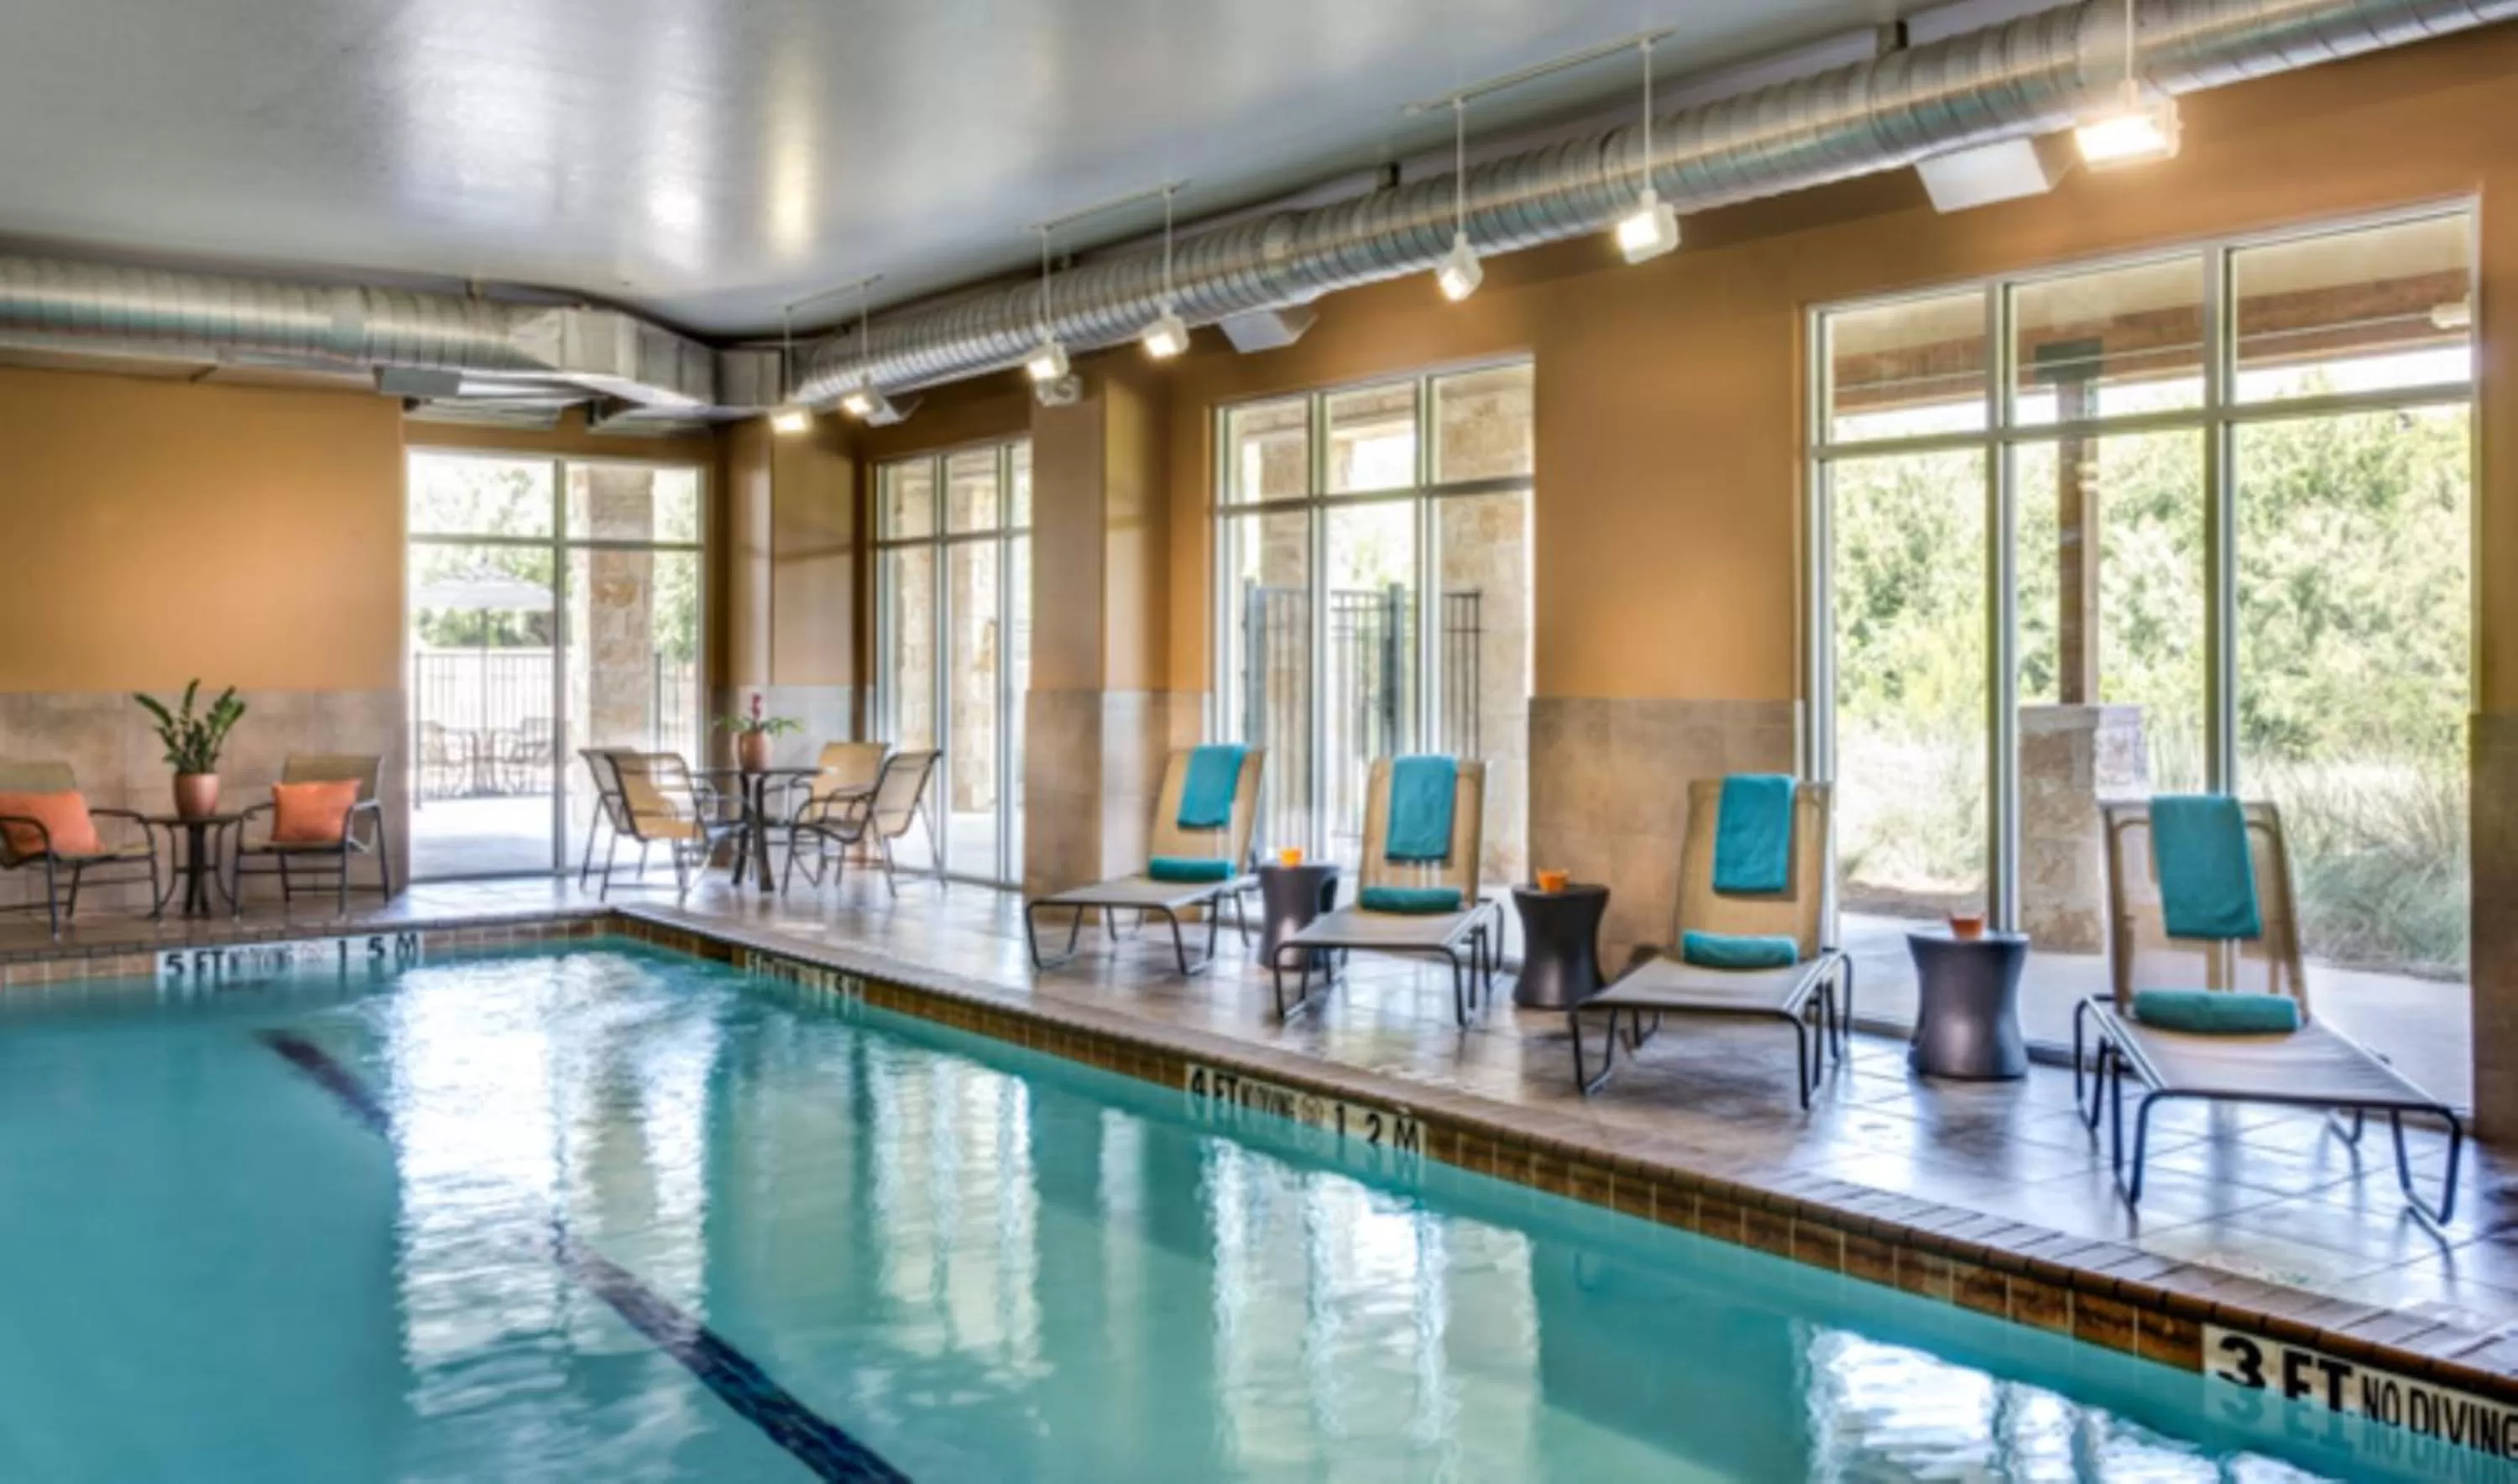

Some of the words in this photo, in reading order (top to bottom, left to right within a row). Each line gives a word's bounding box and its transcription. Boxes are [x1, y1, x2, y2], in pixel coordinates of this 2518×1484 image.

[2217, 1335, 2266, 1389] 3
[2282, 1347, 2354, 1413] FT
[2362, 1374, 2401, 1427] NO
